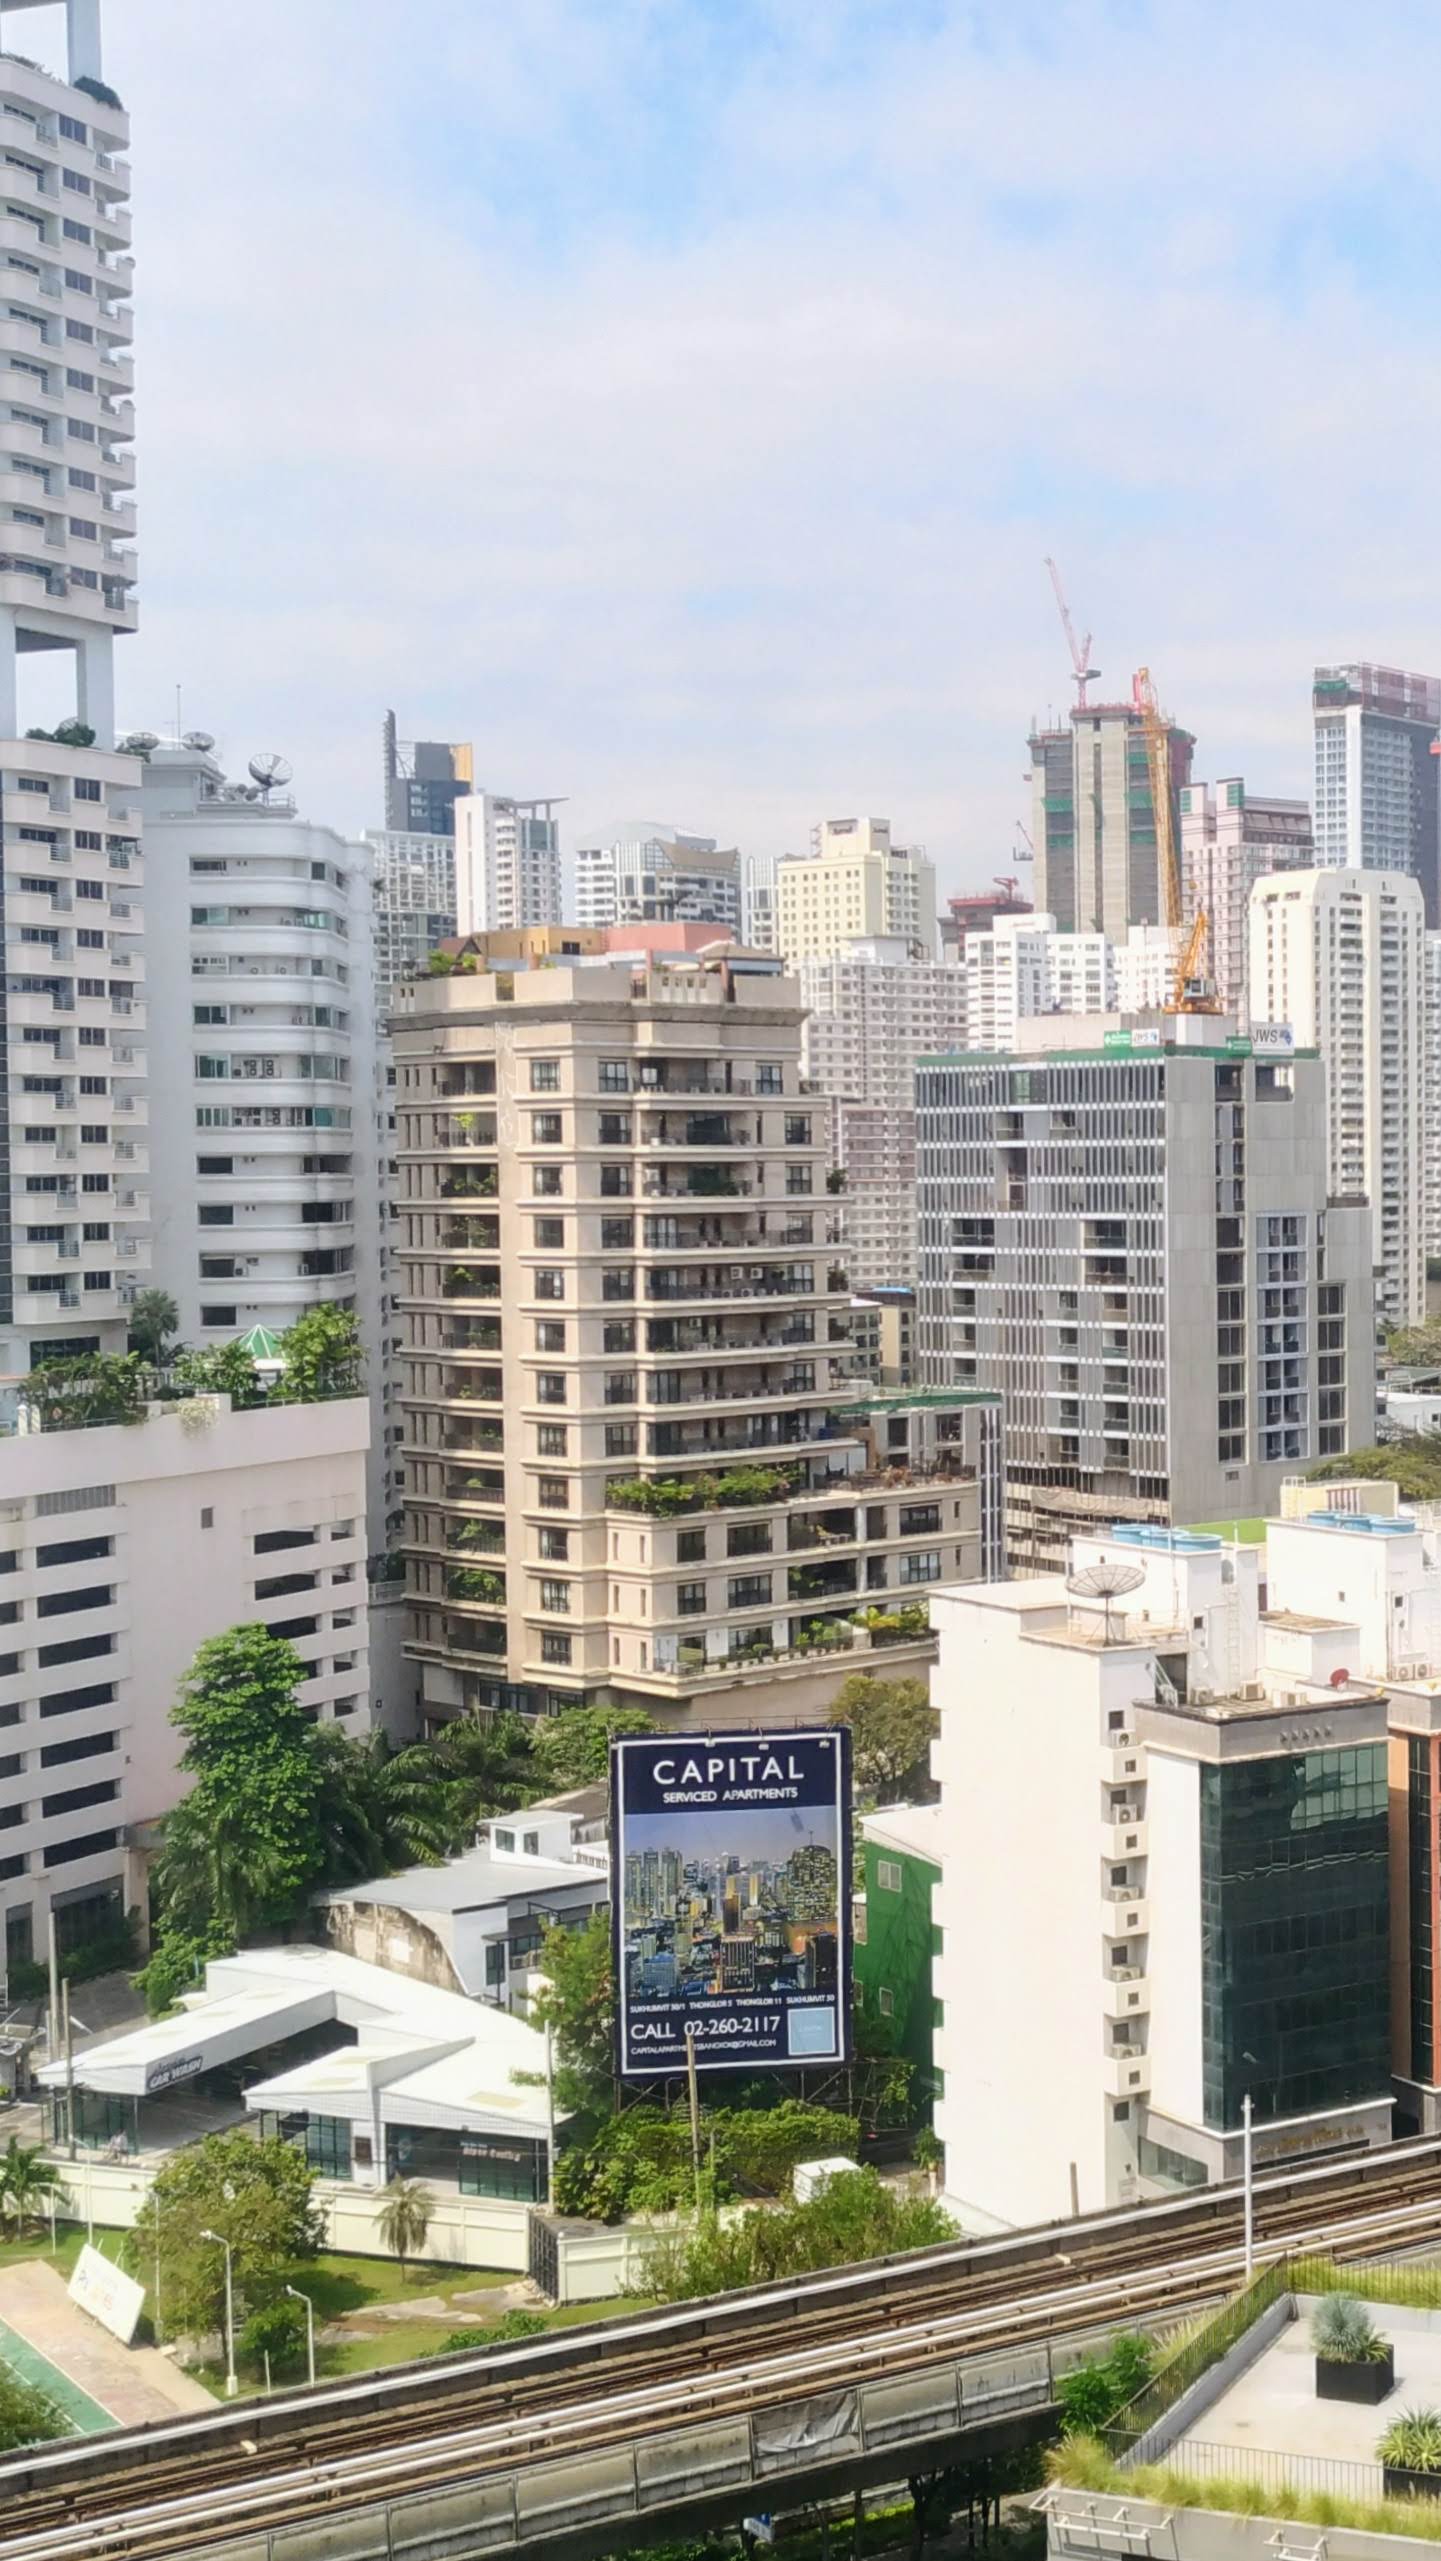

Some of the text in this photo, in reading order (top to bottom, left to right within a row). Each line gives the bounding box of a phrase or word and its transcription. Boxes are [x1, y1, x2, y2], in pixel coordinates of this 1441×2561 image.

[1253, 1029, 1278, 1043] JWS
[653, 1755, 804, 1785] CAPITAL
[663, 1787, 798, 1803] SERVICED APARTMENTS
[630, 2003, 669, 2014] SUKHUMVIT
[689, 2000, 727, 2009] THONGLOR
[736, 1998, 773, 2006] THONGLOR
[786, 1995, 825, 2004] SUKHUMVIT
[631, 2022, 676, 2039] CALL
[684, 2016, 780, 2036] 02-260-2117
